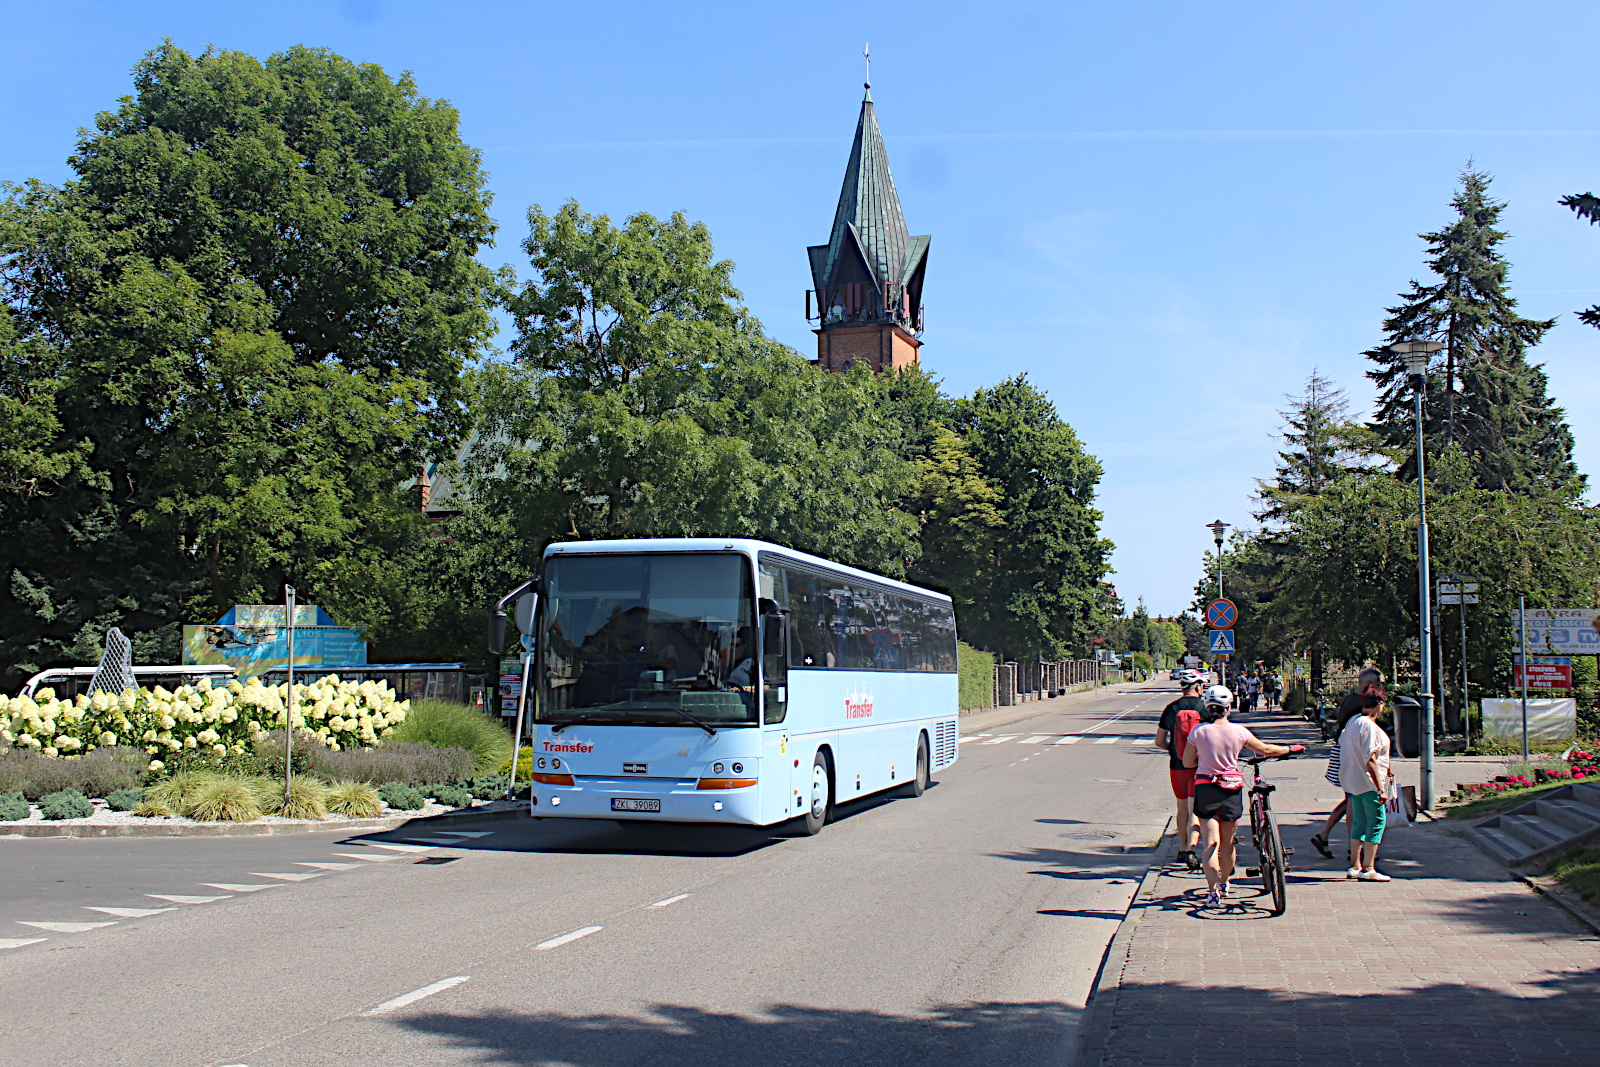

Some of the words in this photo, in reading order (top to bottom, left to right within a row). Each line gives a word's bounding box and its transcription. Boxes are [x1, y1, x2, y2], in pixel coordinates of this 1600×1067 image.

[845, 698, 874, 720] Transfer
[542, 741, 594, 754] Transfer
[615, 799, 631, 810] ZKL
[633, 800, 659, 811] 39089
